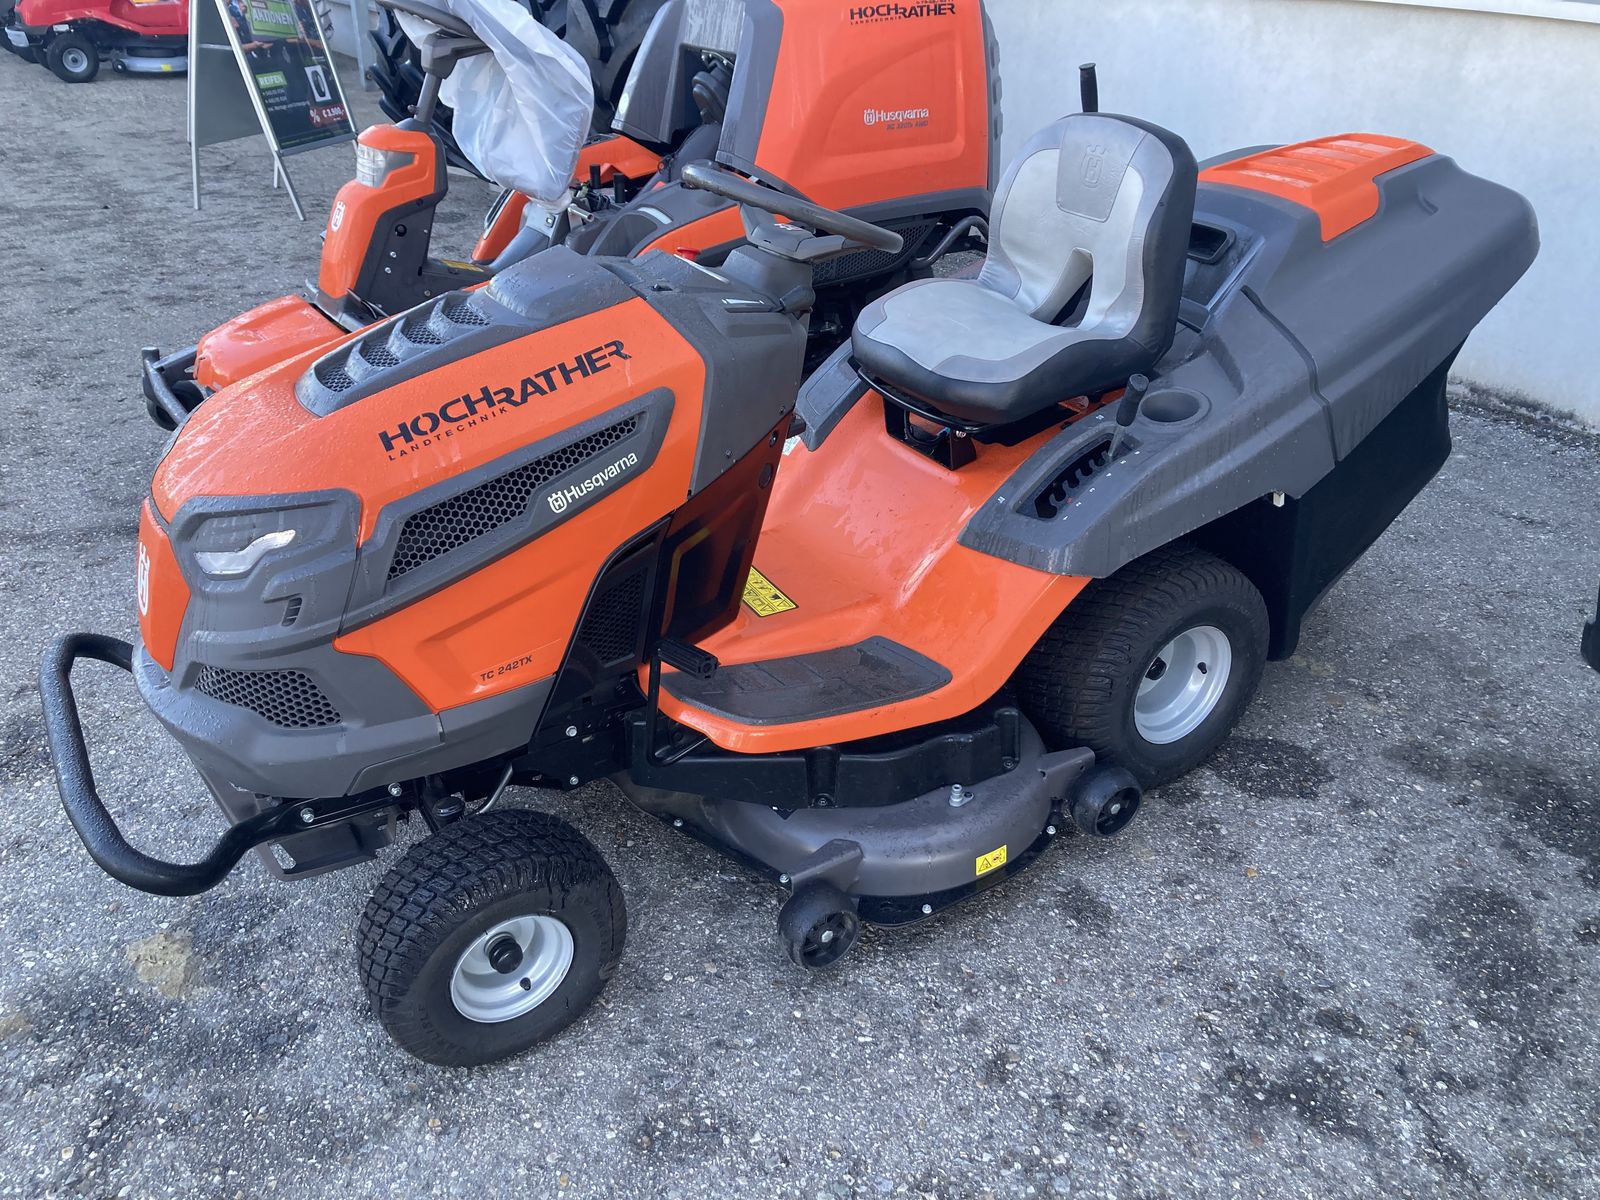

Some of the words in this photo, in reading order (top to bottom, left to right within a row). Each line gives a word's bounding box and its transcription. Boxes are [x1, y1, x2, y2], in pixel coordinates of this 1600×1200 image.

[253, 9, 294, 25] AKTIONEN
[849, 3, 956, 20] HOCHRATHER
[258, 76, 284, 86] REIFEN
[875, 108, 929, 122] Husqvarna
[378, 339, 632, 453] HOCHRATHER
[388, 406, 508, 461] LANDTECHNIK
[564, 452, 638, 504] Husqvarna
[480, 670, 495, 681] TC
[498, 655, 532, 675] 242TX
